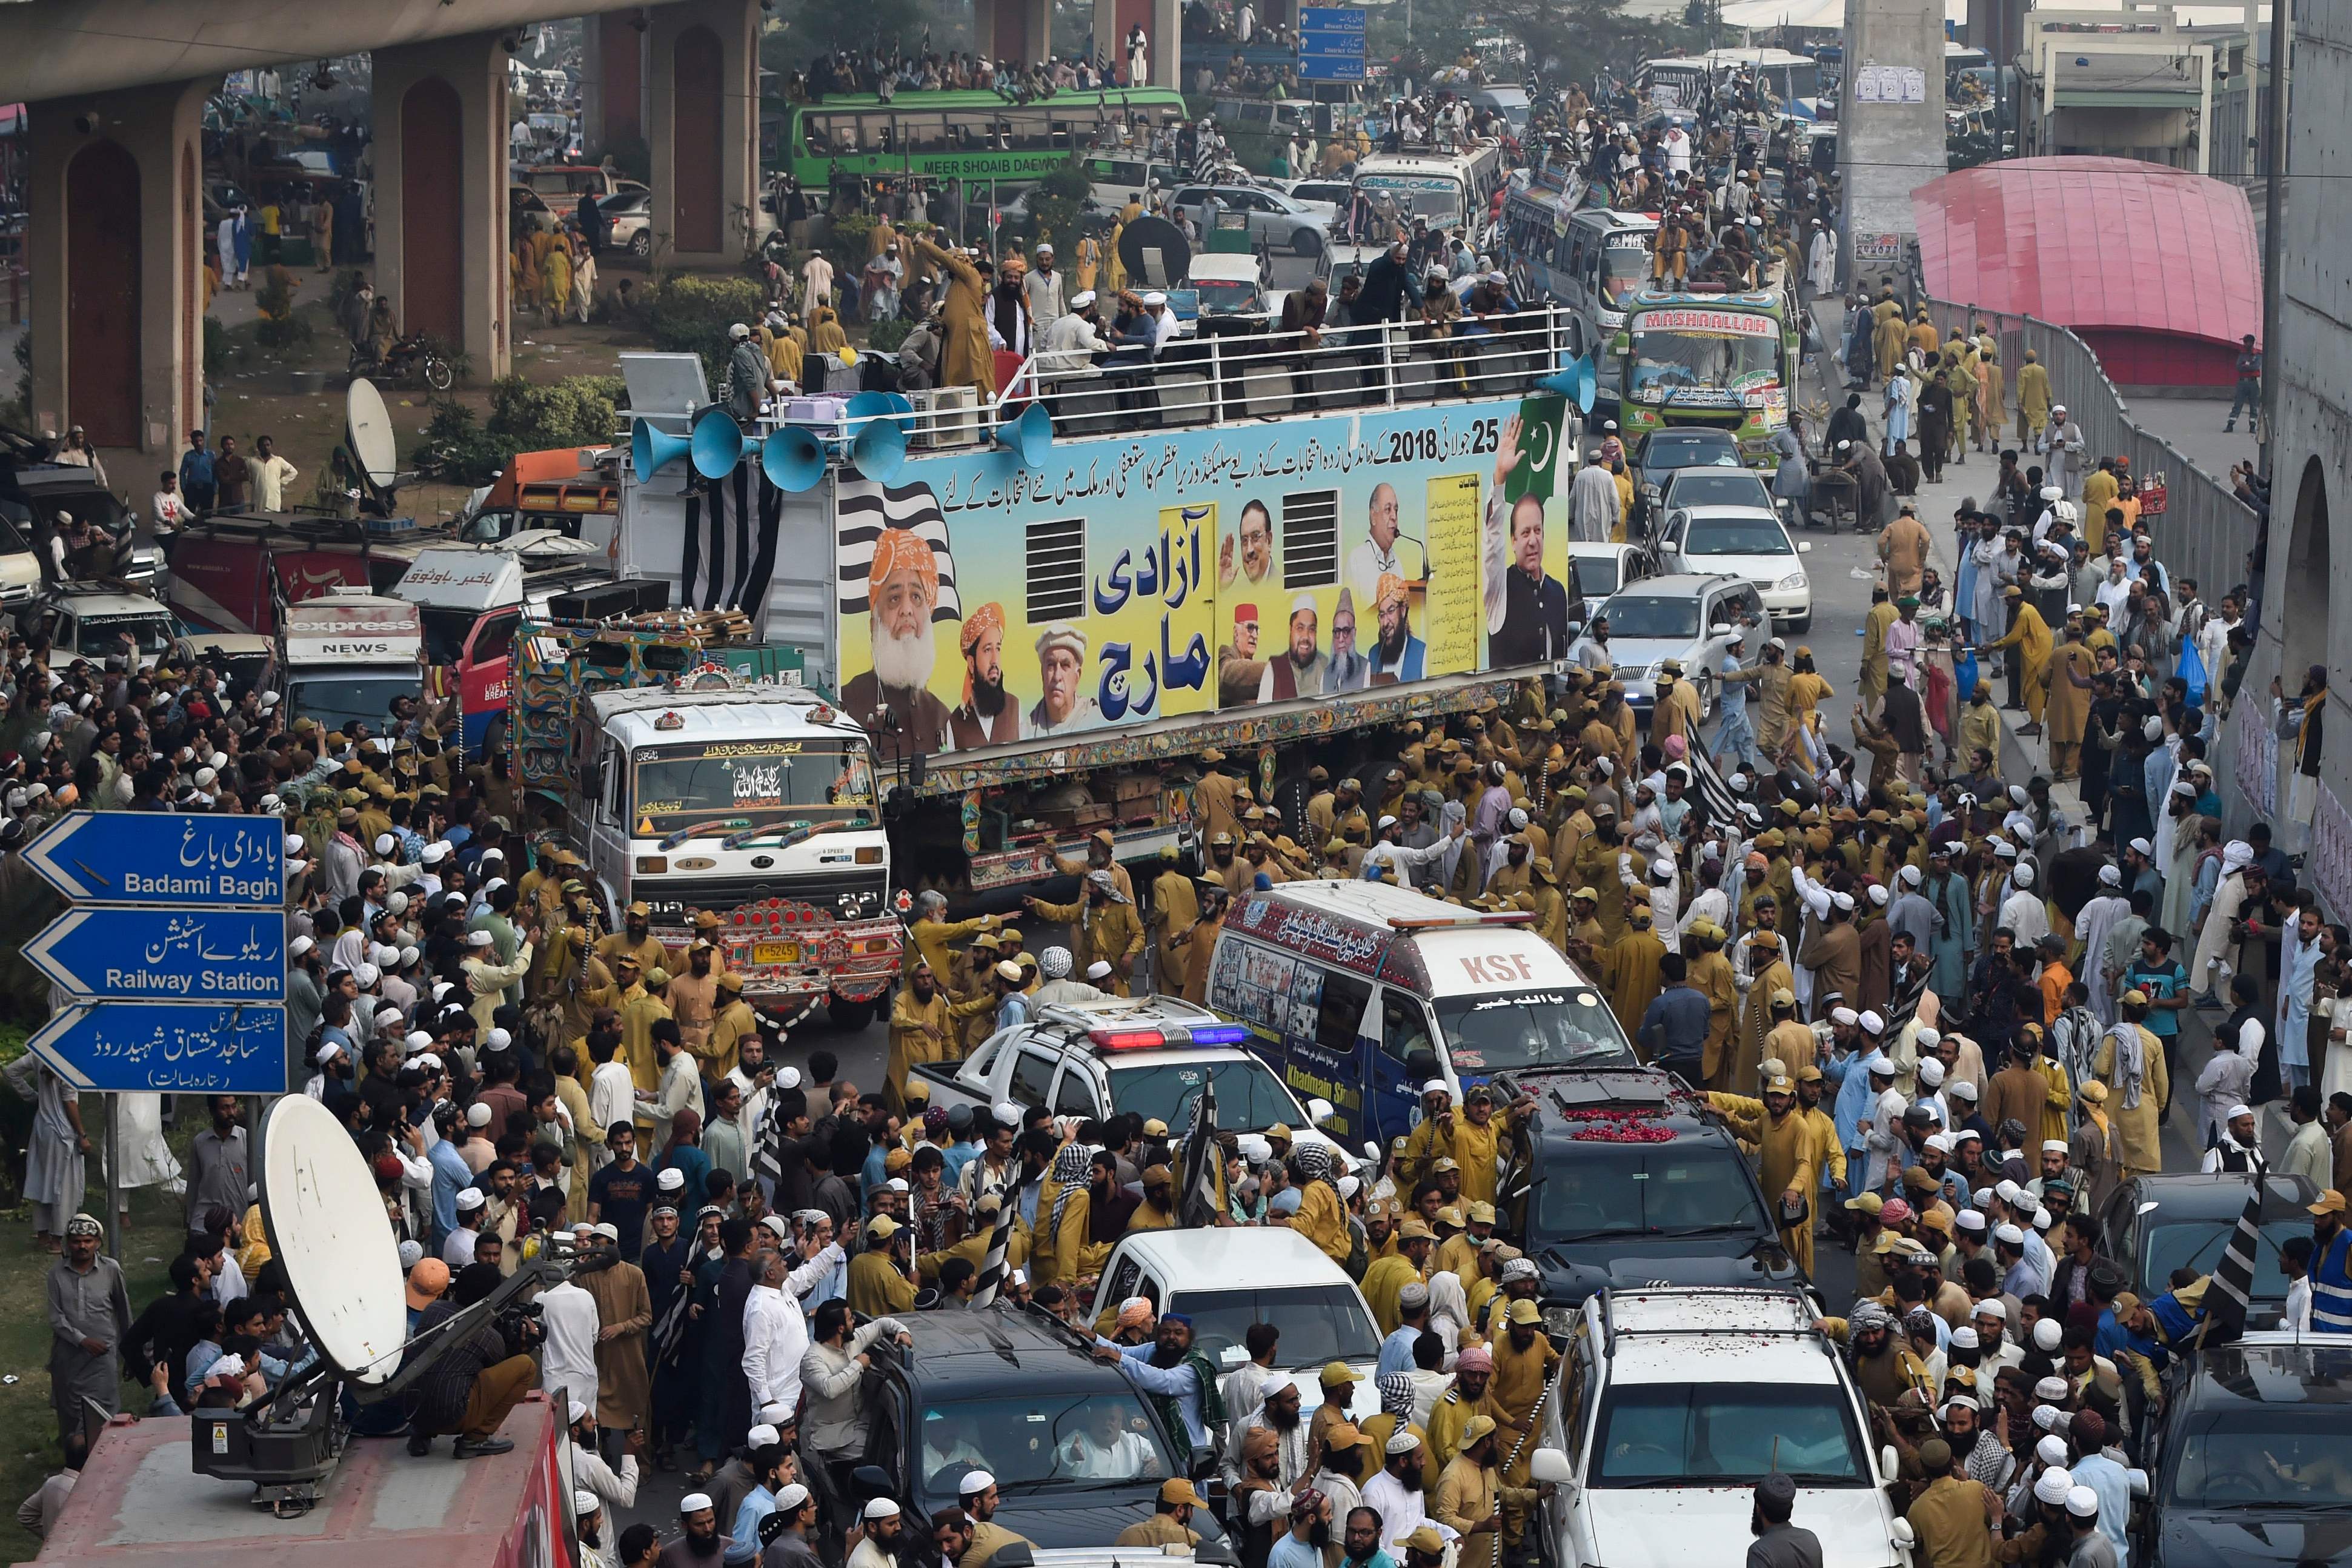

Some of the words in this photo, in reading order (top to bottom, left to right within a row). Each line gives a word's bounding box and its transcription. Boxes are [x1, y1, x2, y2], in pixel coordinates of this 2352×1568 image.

[924, 159, 960, 174] MEER
[963, 158, 1011, 173] SHOAIB
[1644, 312, 1768, 333] MASHAALLAH
[1341, 421, 1374, 474] دھاندلی
[1373, 428, 1390, 465] کے
[1389, 428, 1437, 463] 2018
[1438, 415, 1471, 463] جولائی
[1472, 418, 1500, 454] 25
[1200, 439, 1232, 485] سلیکٹڈ
[1229, 450, 1263, 488] ذریعے
[1263, 439, 1281, 477] کے
[1281, 436, 1323, 482] انتخابات
[1323, 445, 1341, 471] زدہ
[965, 471, 985, 510] کے
[986, 468, 1031, 515] انتخابات
[1032, 473, 1053, 503] نئے
[1054, 466, 1074, 506] میں
[1075, 456, 1099, 498] ملک
[1098, 466, 1115, 496] اور
[402, 568, 452, 585] باوثوق
[1093, 505, 1210, 616] آزادی
[456, 571, 494, 587] باخبر
[292, 620, 416, 633] express
[322, 643, 388, 653] NEWS
[1097, 612, 1212, 722] مارچ
[485, 682, 501, 693] LIVE
[180, 819, 217, 871] باغ
[221, 829, 274, 871] بادامی
[125, 873, 211, 895] Badami
[219, 874, 278, 900] Bagh
[145, 916, 205, 963] اسٹیشن
[202, 924, 277, 962] ریلوے
[759, 947, 765, 956] K
[770, 945, 792, 956] 5245
[106, 969, 192, 994] Railway
[201, 971, 279, 991] Station
[1459, 954, 1532, 983] KSF
[1473, 997, 1511, 1011] خیر
[93, 1031, 123, 1057] روڈ
[122, 1026, 165, 1063] شہید
[164, 1028, 218, 1061] مشتاق
[216, 1035, 259, 1065] ساجد
[1287, 1063, 1332, 1100] Khadmain
[1334, 1082, 1360, 1112] Sindh
